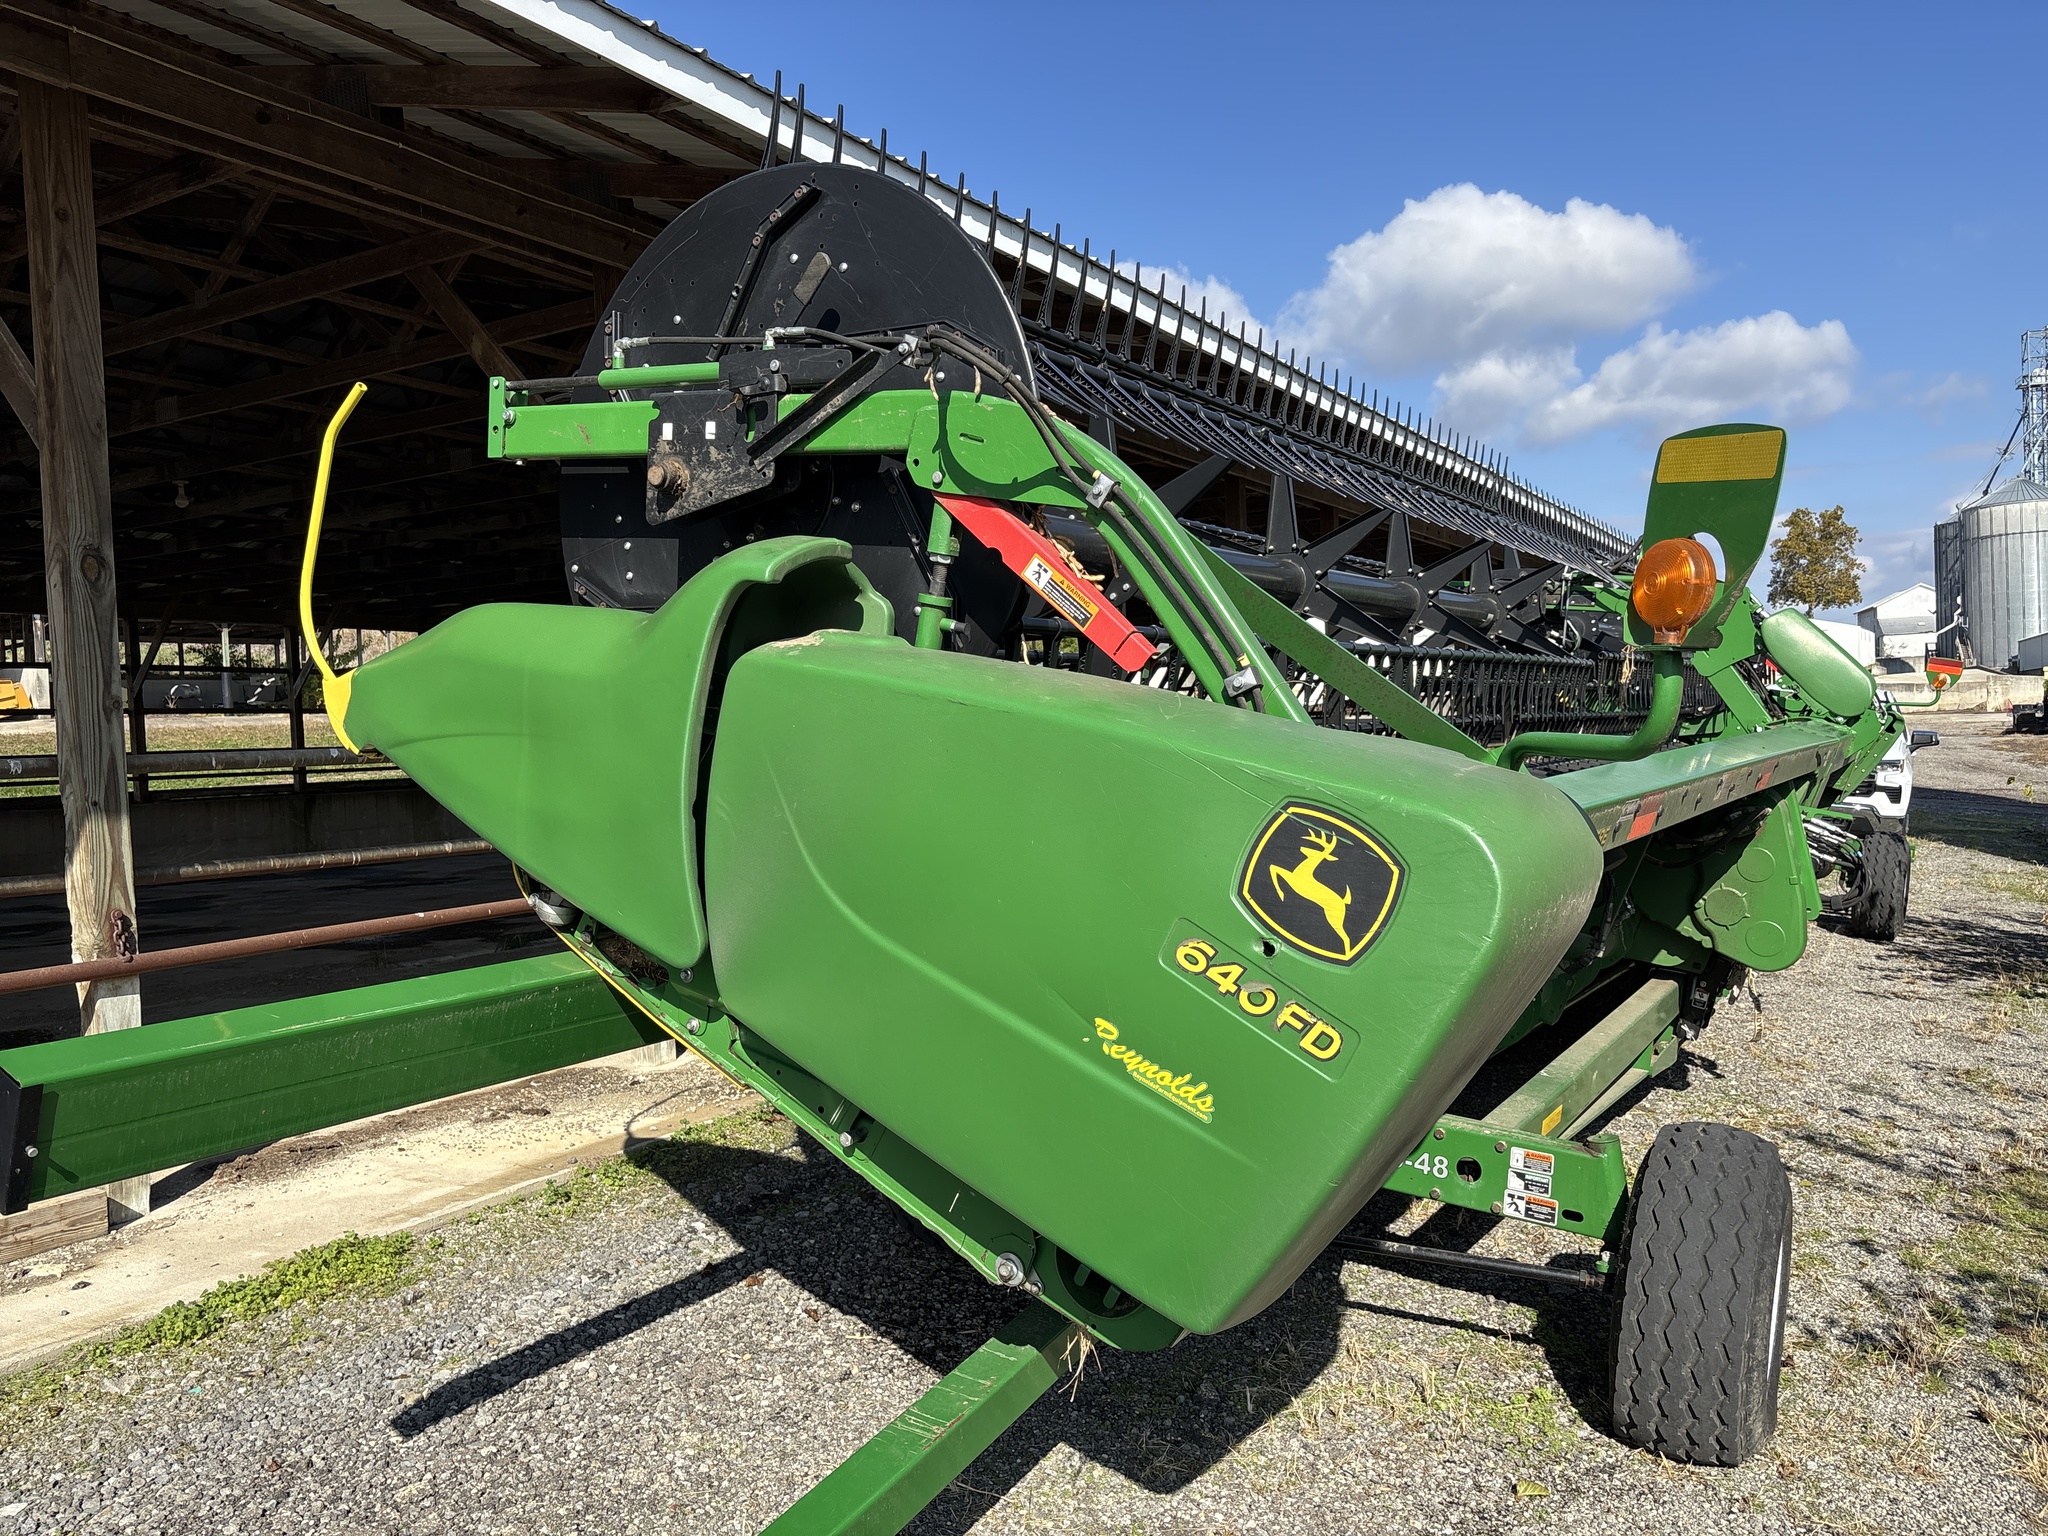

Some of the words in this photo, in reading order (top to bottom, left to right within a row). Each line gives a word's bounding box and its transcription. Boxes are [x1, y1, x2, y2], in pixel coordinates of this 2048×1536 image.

[1065, 582, 1091, 609] WARNING
[1175, 939, 1278, 1018] 640
[1274, 1001, 1343, 1062] FD
[1094, 1017, 1215, 1112] Reynolds
[1398, 1152, 1449, 1179] -48
[1530, 1152, 1551, 1161] WARNING
[1532, 1197, 1555, 1207] WARNING
